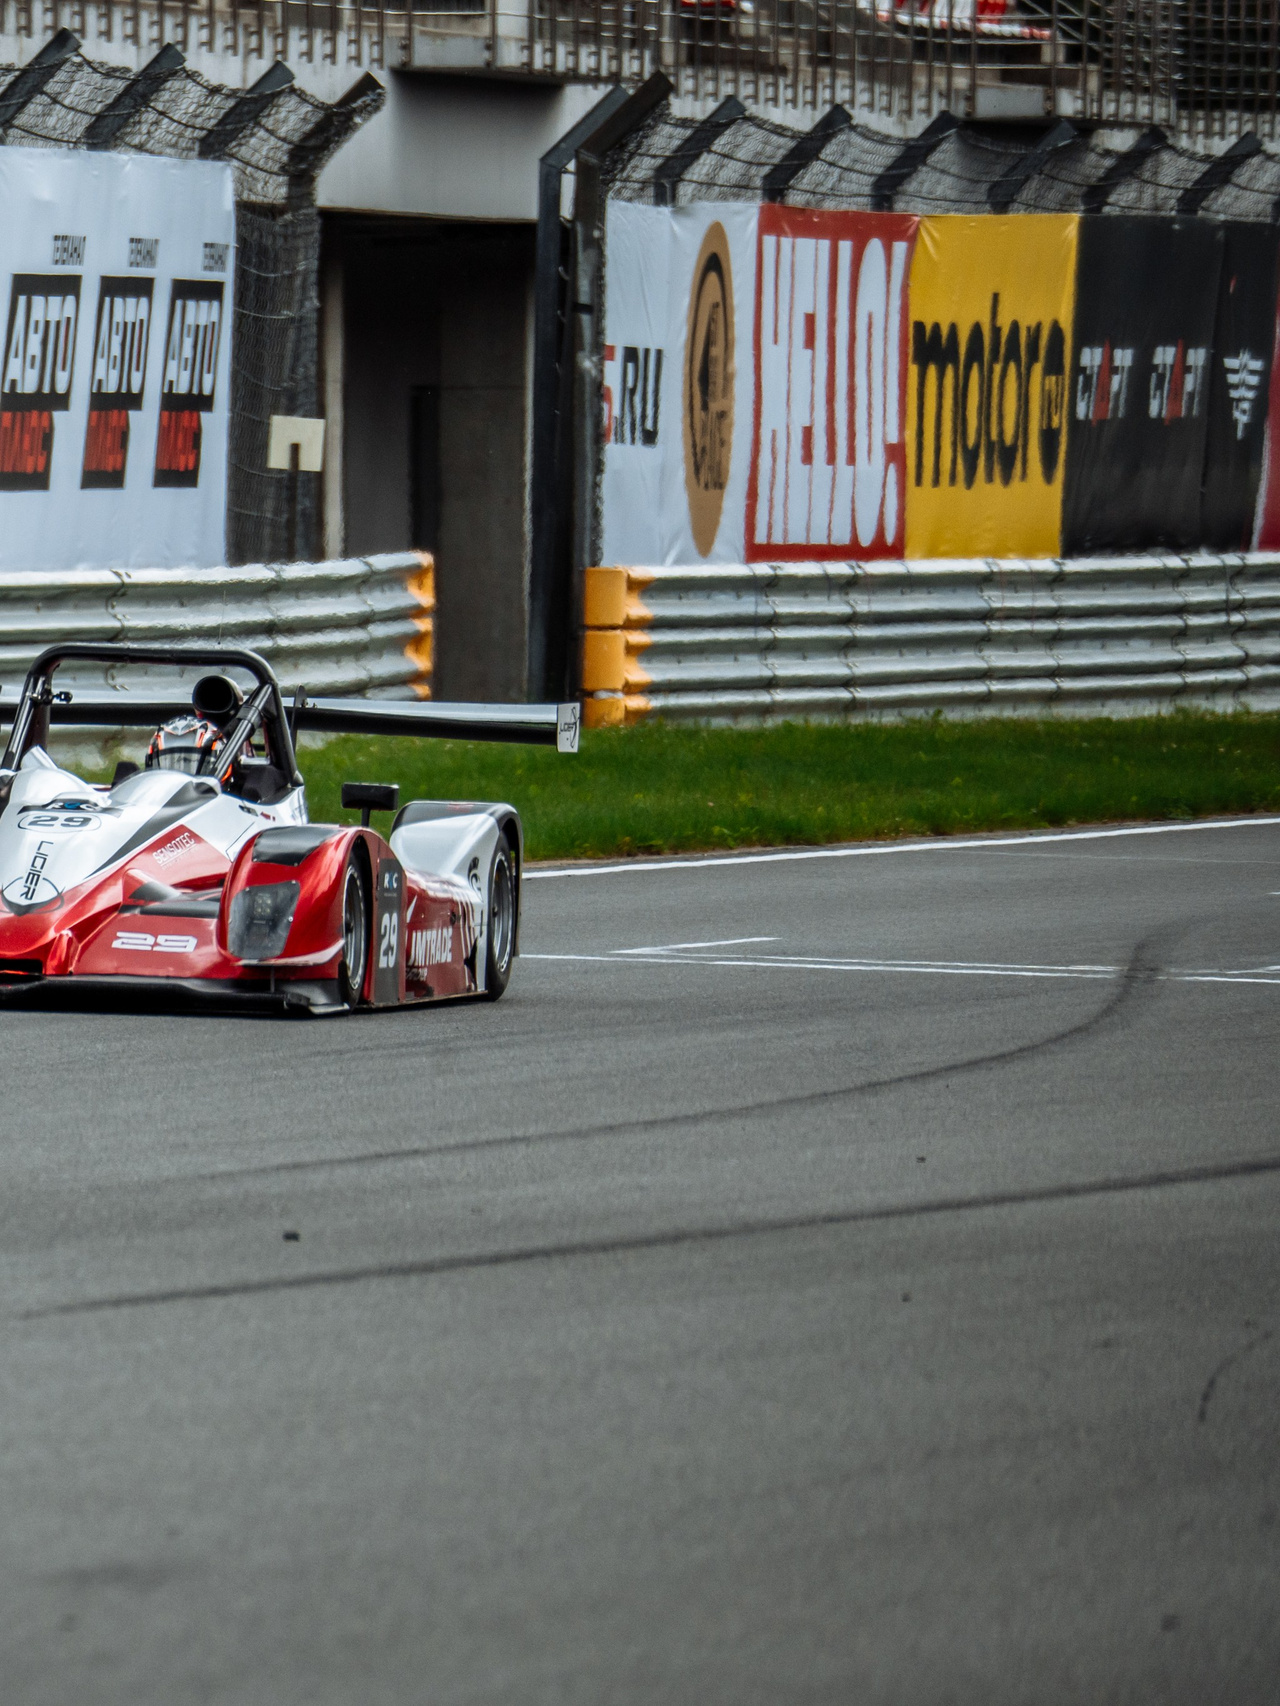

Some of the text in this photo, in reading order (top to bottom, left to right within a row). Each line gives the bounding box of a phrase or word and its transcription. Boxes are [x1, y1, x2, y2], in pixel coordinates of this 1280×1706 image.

[2, 294, 77, 394] АВТО
[91, 296, 150, 394] АВТО
[162, 299, 219, 396] АВТО
[753, 235, 909, 547] HELLO!
[27, 814, 92, 828] 29
[152, 832, 195, 865] SENSOTEC
[111, 931, 198, 953] 29
[378, 912, 399, 969] 29
